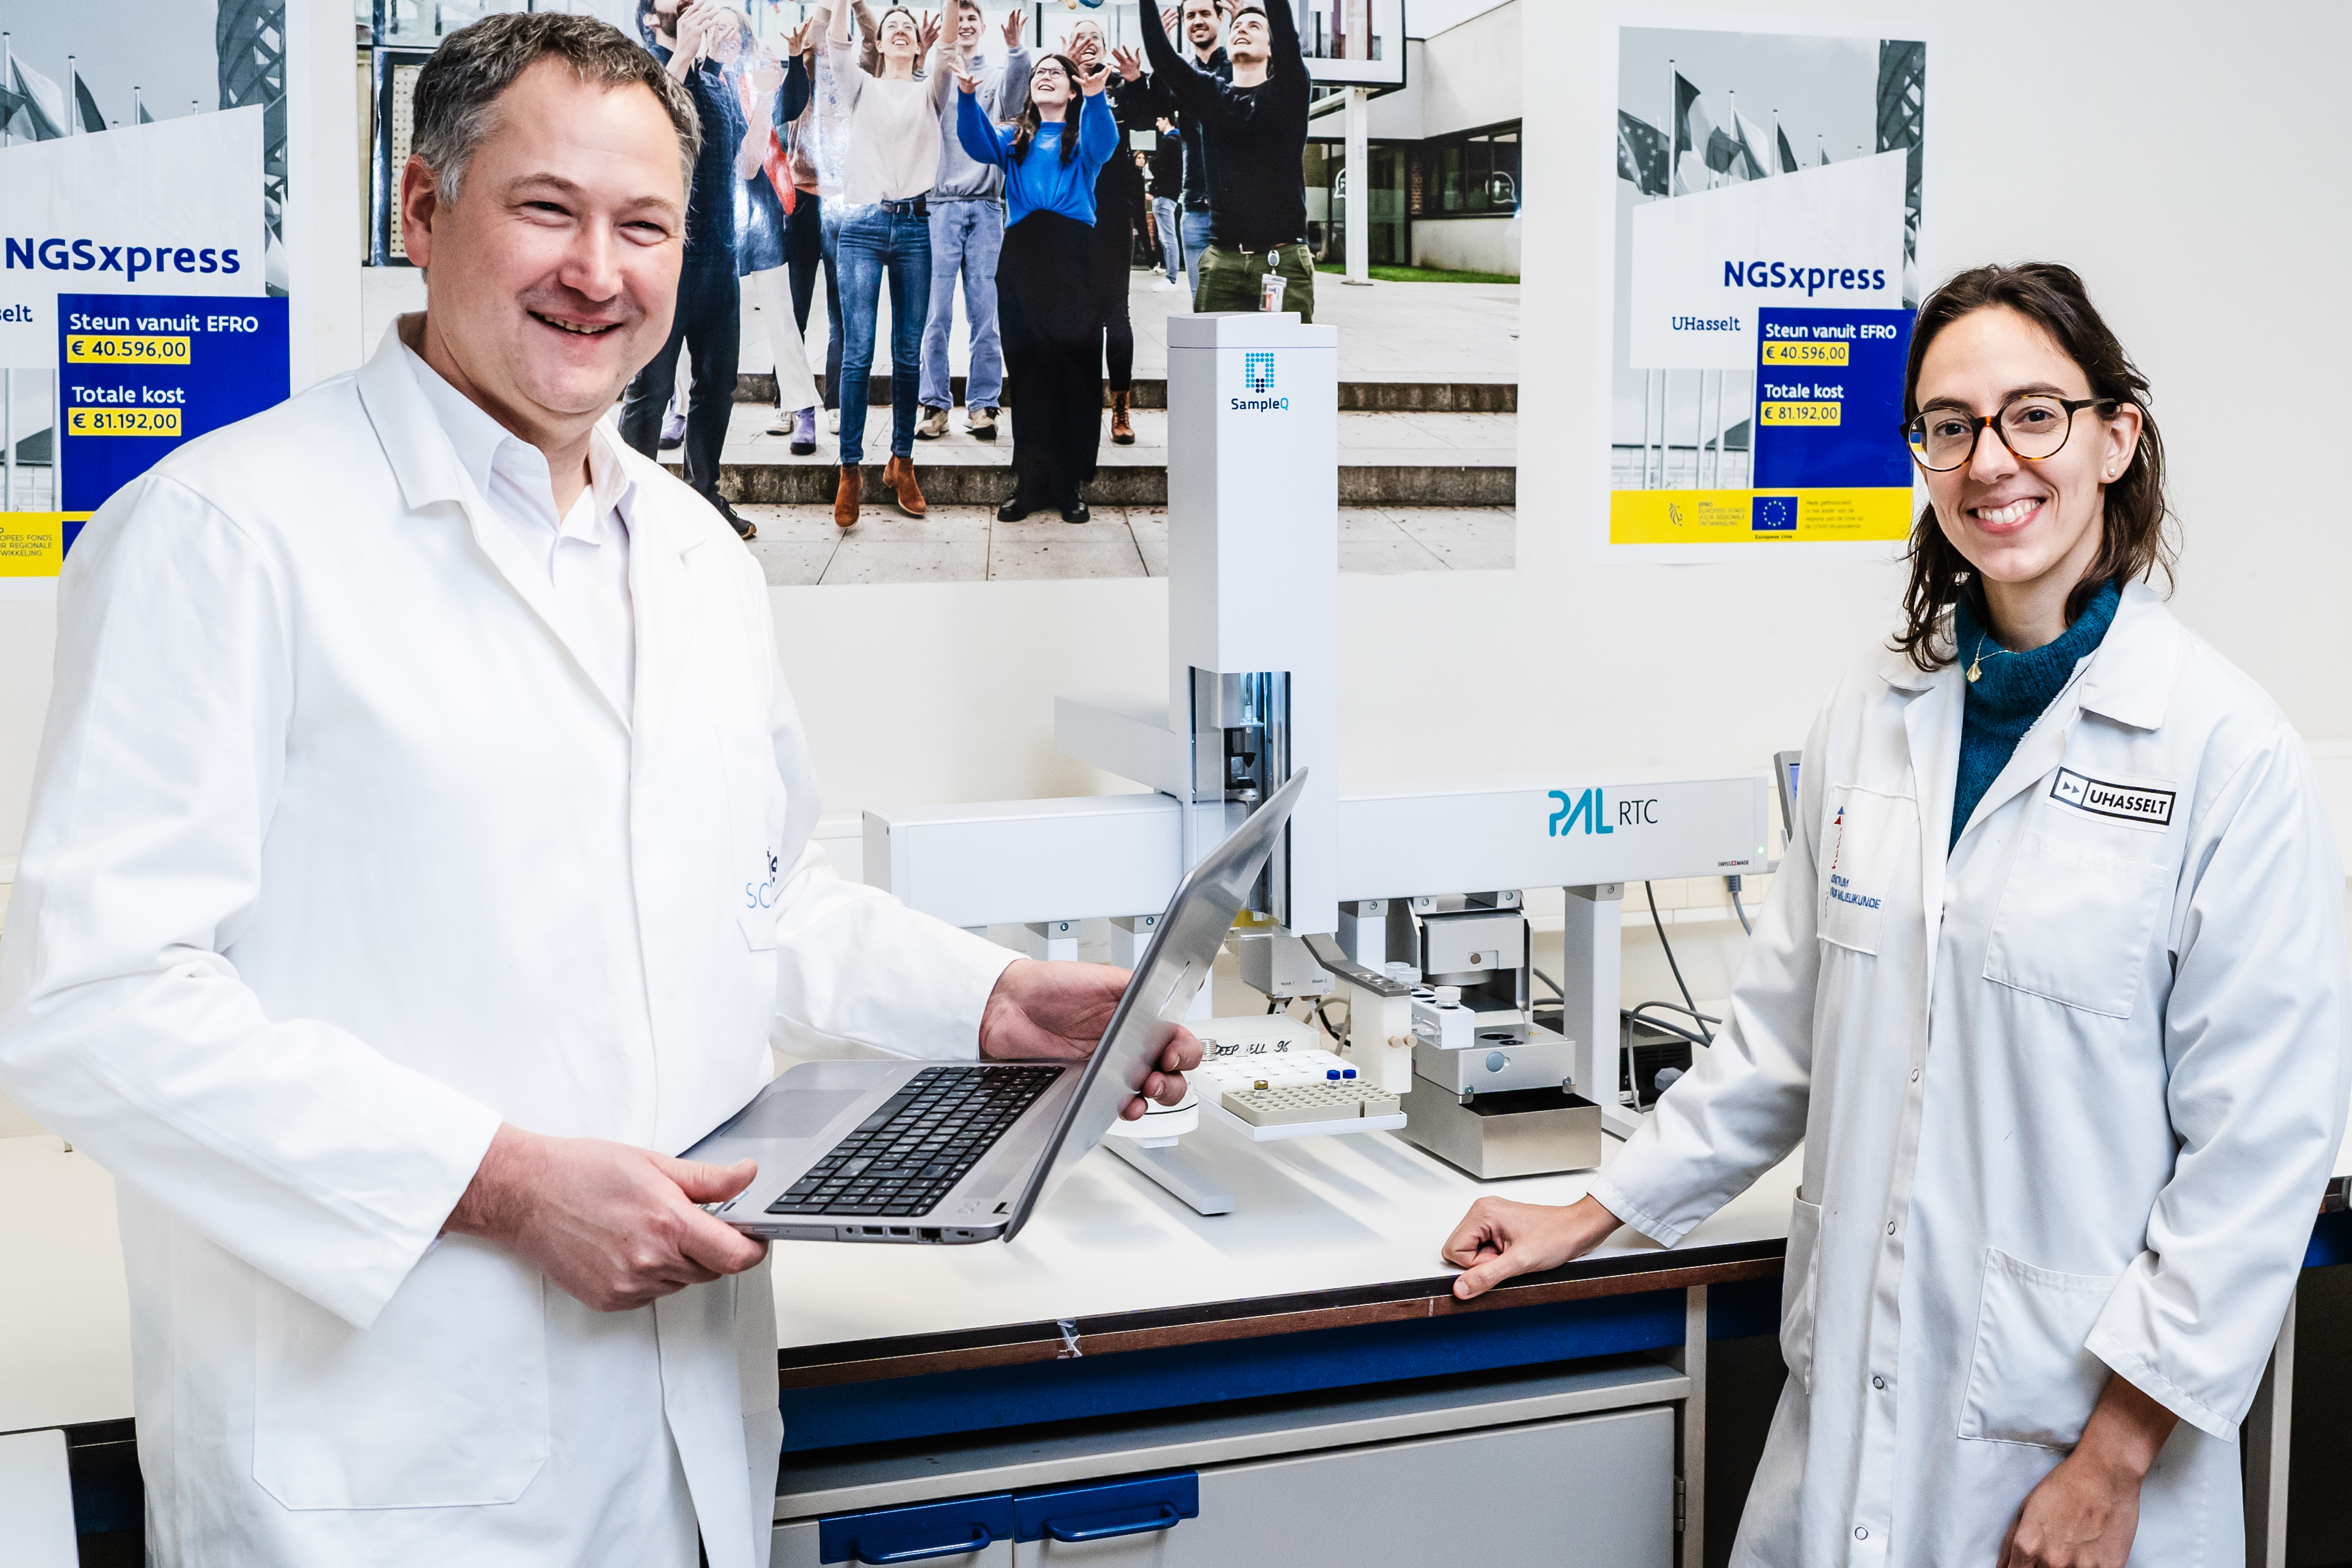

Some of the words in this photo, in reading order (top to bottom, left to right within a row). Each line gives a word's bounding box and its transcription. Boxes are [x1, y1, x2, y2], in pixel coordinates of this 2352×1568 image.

[6, 238, 240, 282] NGSxpress
[1724, 261, 1885, 297] NGSxpress
[0, 304, 33, 322] elt
[70, 313, 130, 331] Steun
[136, 314, 201, 332] vanuit
[207, 315, 258, 332] EFRO
[1672, 316, 1740, 331] UHasselt
[1766, 323, 1808, 338] Steun
[1812, 323, 1857, 339] vanuit
[1860, 324, 1897, 339] EFRO
[71, 341, 85, 356] €
[92, 341, 186, 359] 40.596,00
[1767, 347, 1775, 359] €
[1780, 347, 1845, 361] 40.596,00
[71, 385, 136, 403] Totale
[142, 386, 186, 404] kost
[1764, 383, 1810, 399] Totale
[1814, 383, 1845, 399] kost
[1231, 398, 1288, 412] SampleQ
[1764, 407, 1773, 419] €
[1778, 407, 1837, 421] 81.192,00
[73, 413, 86, 429] €
[94, 413, 177, 431] 81.192,00
[2090, 790, 2167, 814] UHASSELT
[1548, 787, 1614, 837] PAL
[1619, 799, 1658, 825] RTC
[1245, 1043, 1268, 1054] ELL
